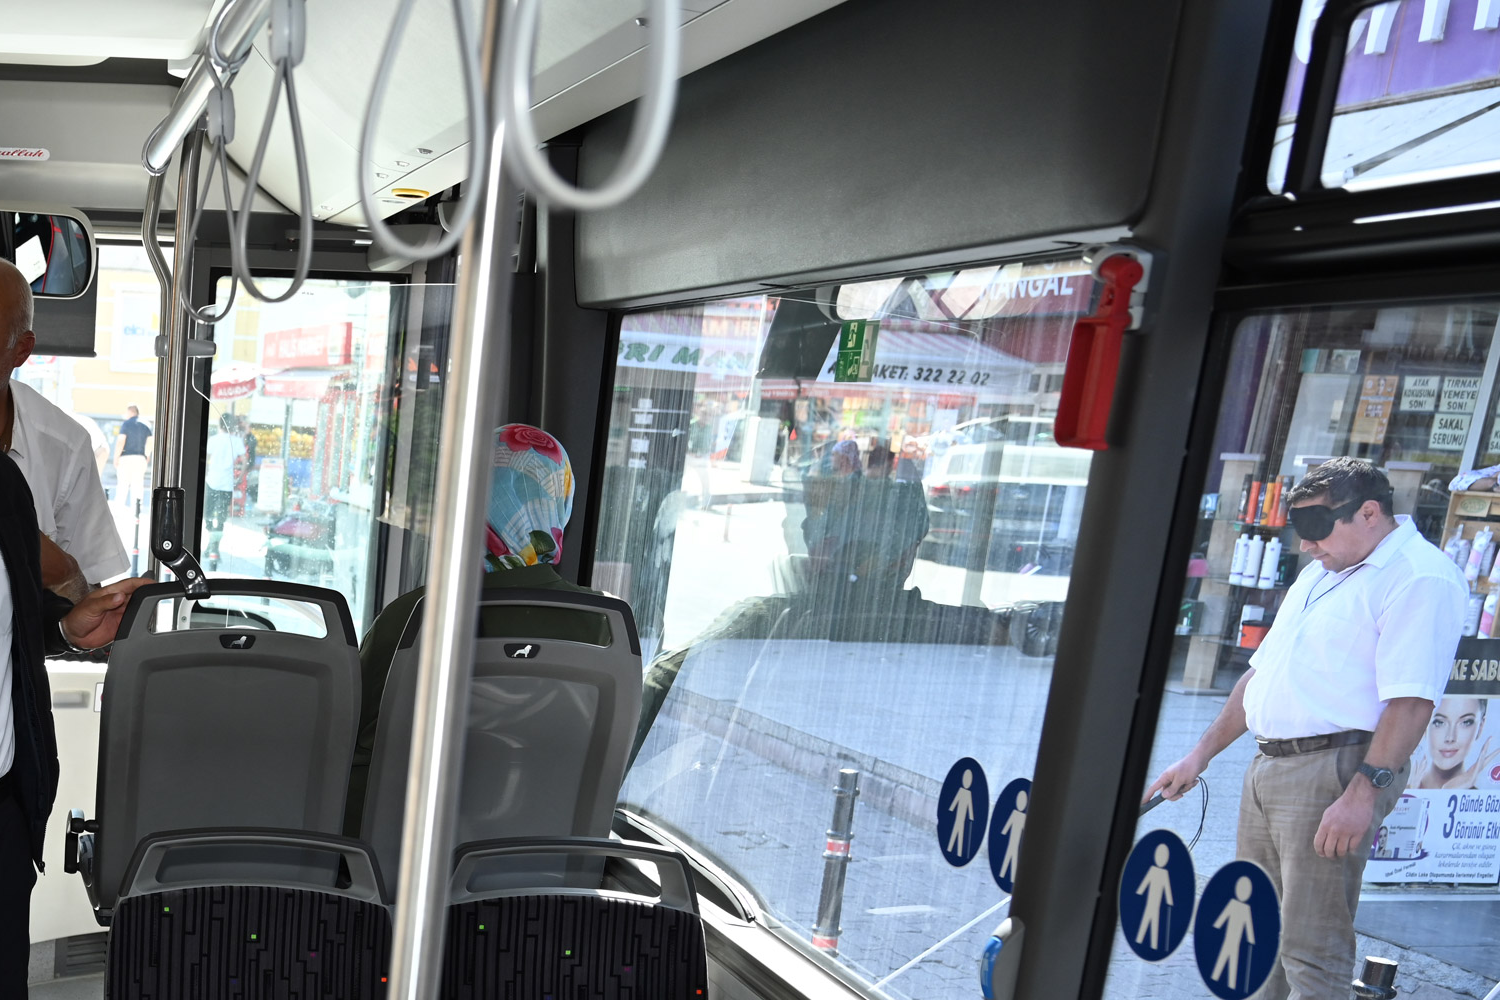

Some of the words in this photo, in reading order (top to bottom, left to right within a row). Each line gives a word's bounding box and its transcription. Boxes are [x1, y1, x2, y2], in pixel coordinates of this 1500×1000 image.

[872, 363, 909, 381] AKET:
[913, 367, 943, 383] 322
[947, 370, 966, 384] 22
[971, 372, 991, 386] 02
[1413, 379, 1430, 387] AYAK
[1446, 380, 1479, 389] TIRNAK
[1403, 389, 1436, 398] KOKUSUNA
[1442, 390, 1477, 400] YEMEYE
[1409, 401, 1427, 409] SON!
[1446, 402, 1467, 411] SON!
[1438, 418, 1464, 431] SAKAL
[1432, 433, 1465, 446] SERUMU
[1442, 794, 1458, 839] 3
[1459, 794, 1484, 813] Günde
[1454, 821, 1485, 839] Görünür
